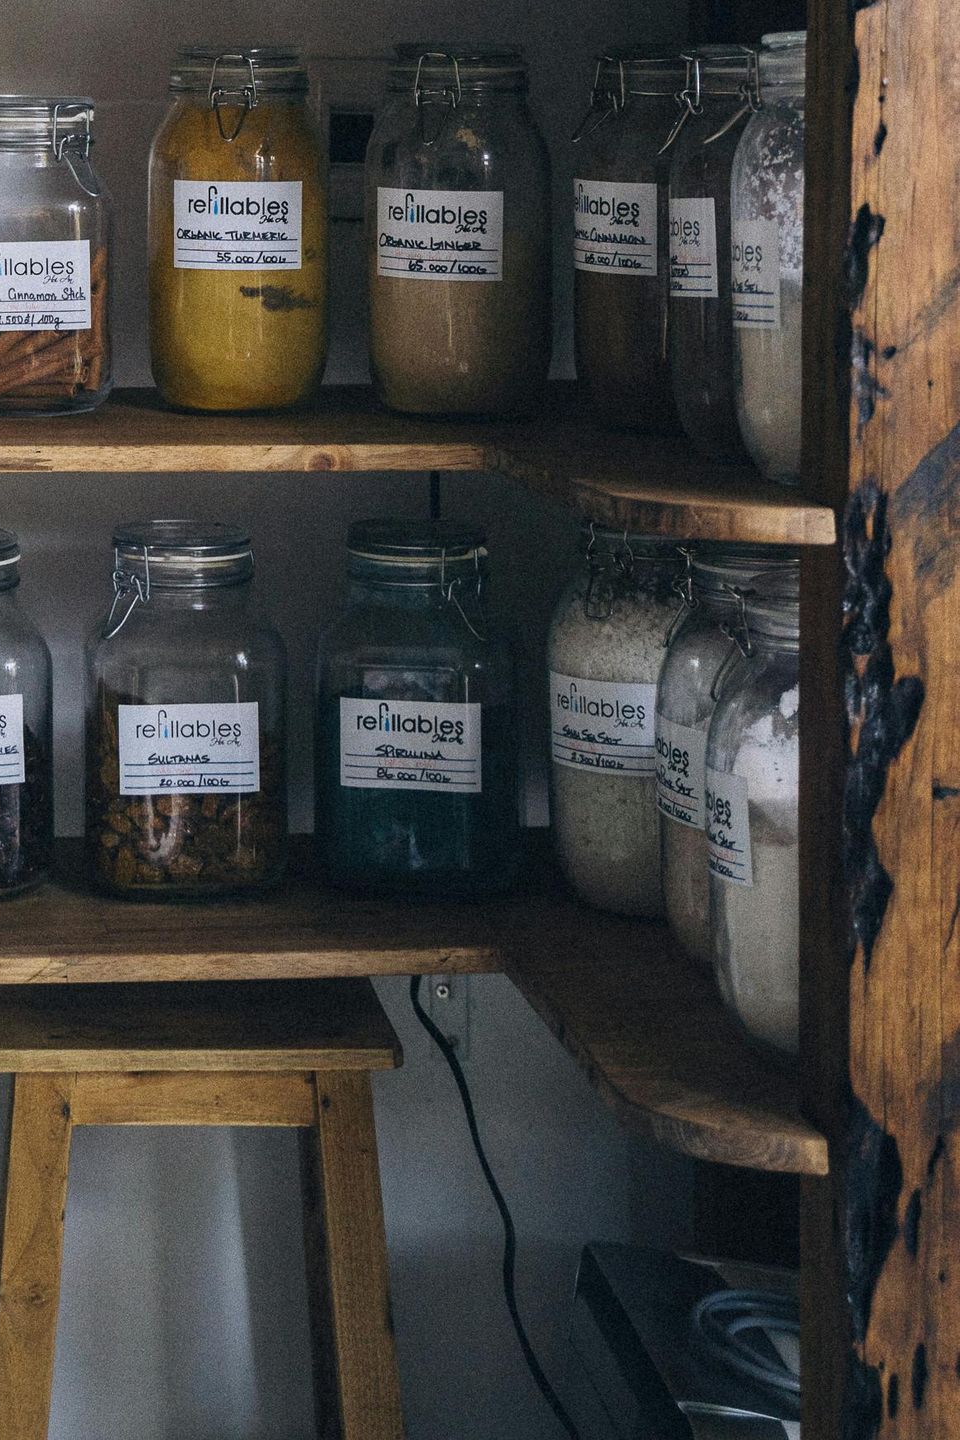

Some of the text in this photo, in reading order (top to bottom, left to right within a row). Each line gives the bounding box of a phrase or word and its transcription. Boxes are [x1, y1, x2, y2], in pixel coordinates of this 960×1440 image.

[188, 186, 289, 216] refillables
[388, 193, 488, 225] refillables
[225, 229, 289, 241] TURMERIC
[379, 232, 428, 249] ORGANIC
[61, 287, 86, 301] Stick
[557, 683, 646, 720] refillables
[136, 710, 242, 739] refillables
[356, 702, 464, 736] refillables
[148, 753, 211, 766] SULTANAS
[375, 744, 447, 761] SPIRULINA
